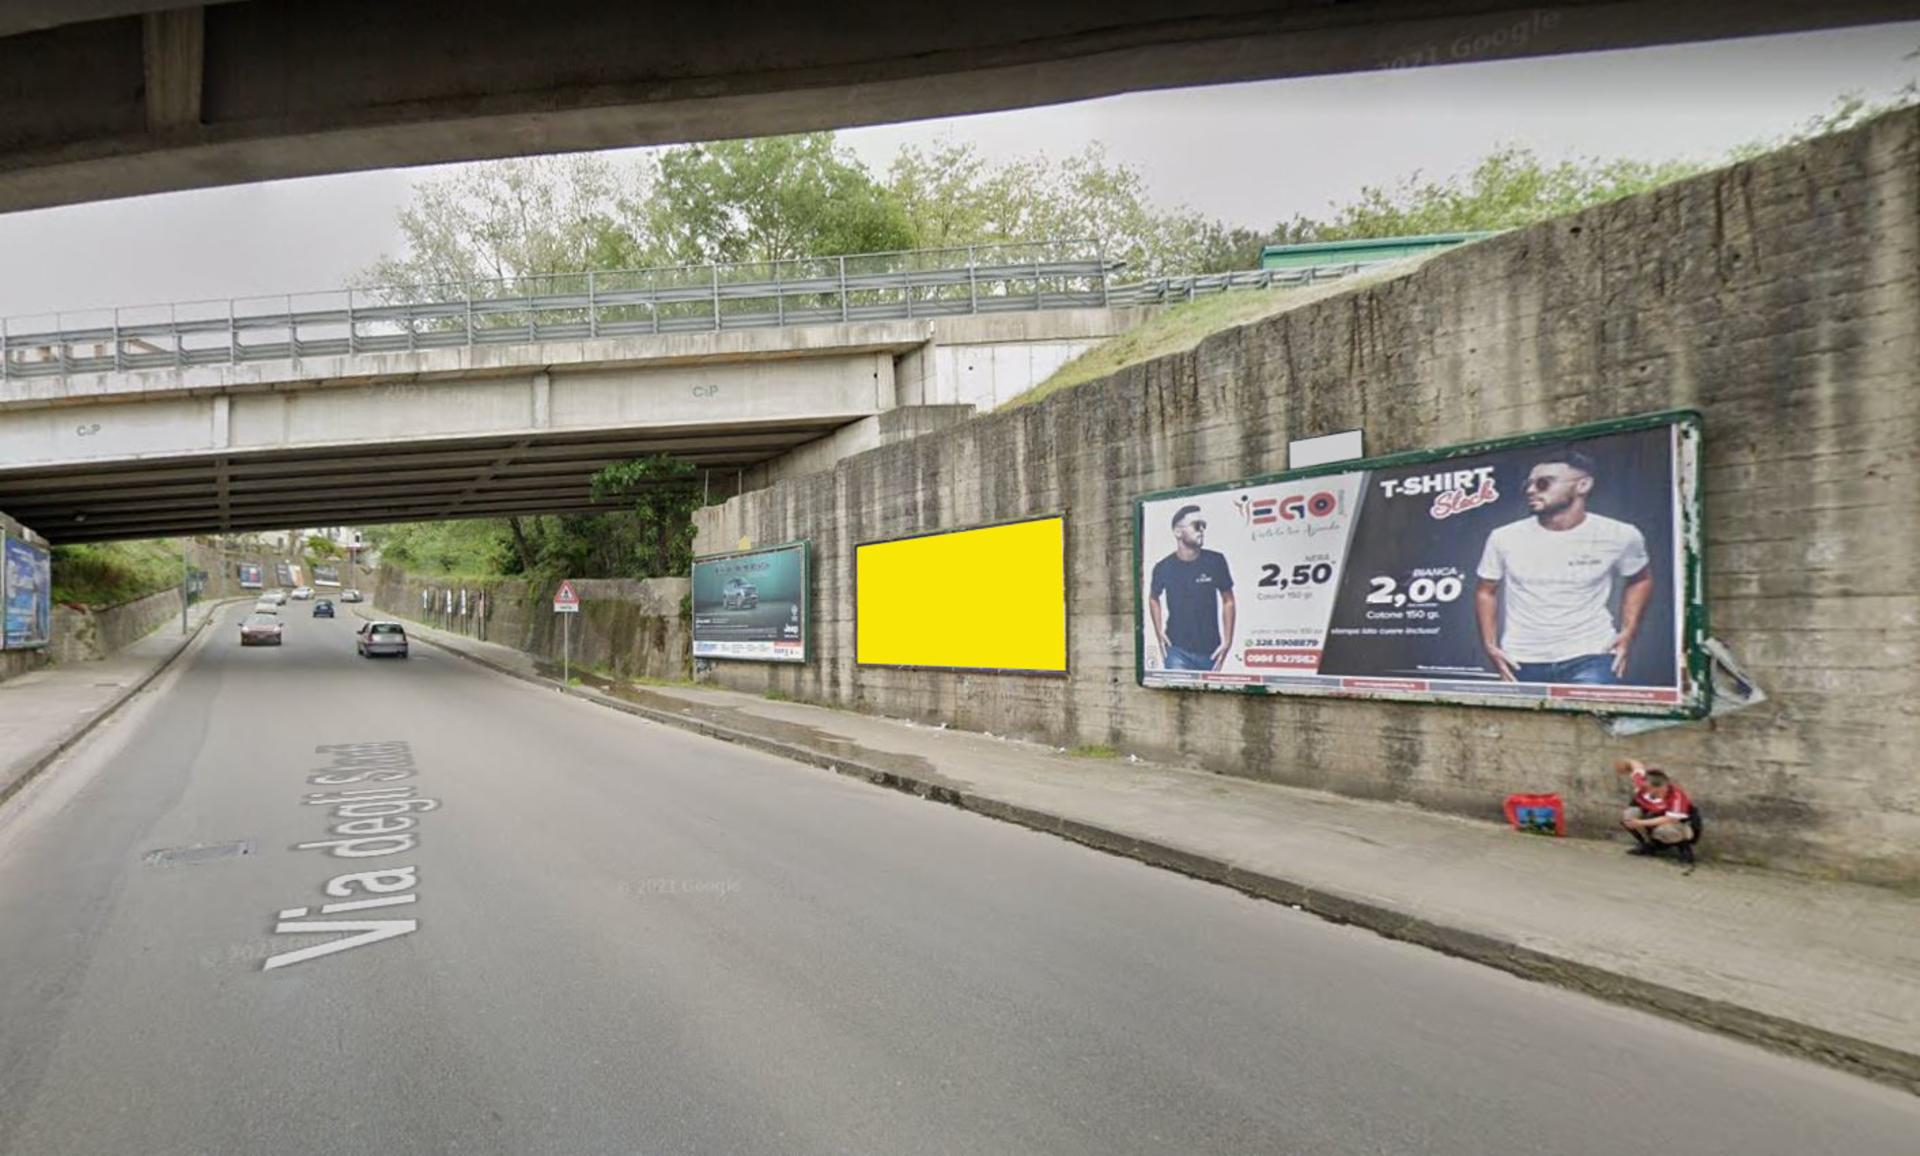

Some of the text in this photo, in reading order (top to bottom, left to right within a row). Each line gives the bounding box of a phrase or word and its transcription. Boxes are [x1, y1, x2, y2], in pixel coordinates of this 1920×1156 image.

[1380, 466, 1494, 498] T-SHIRT
[1430, 477, 1499, 519] Stock
[1412, 566, 1457, 577] BIANCA
[1365, 610, 1403, 619] Cotone
[1405, 609, 1425, 619] 150
